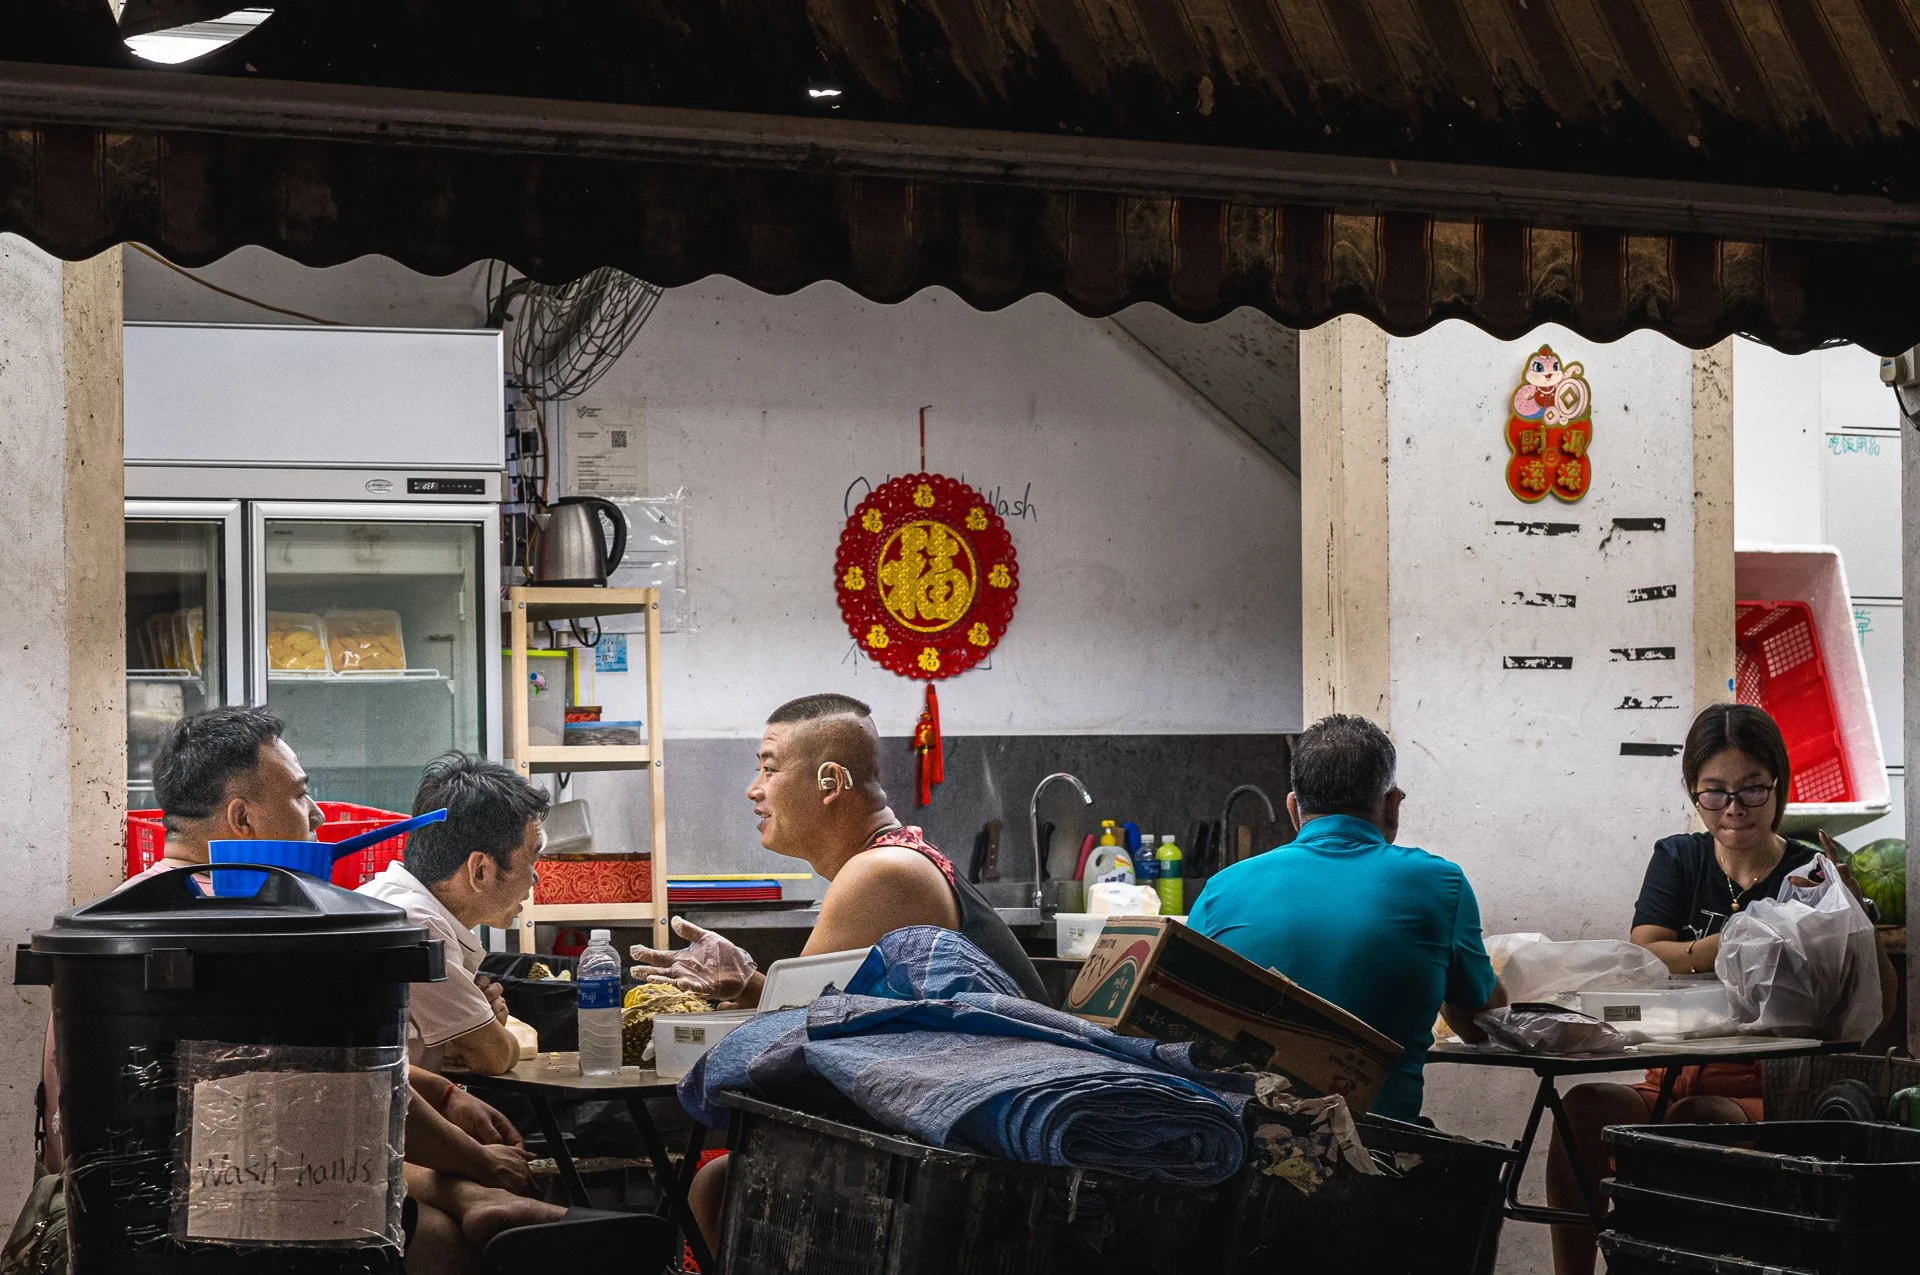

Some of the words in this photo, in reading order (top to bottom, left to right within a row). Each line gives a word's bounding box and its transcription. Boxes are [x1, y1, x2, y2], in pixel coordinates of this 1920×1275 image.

[881, 524, 969, 620] 福
[199, 1154, 277, 1187] Wash
[297, 1148, 371, 1187] hands
